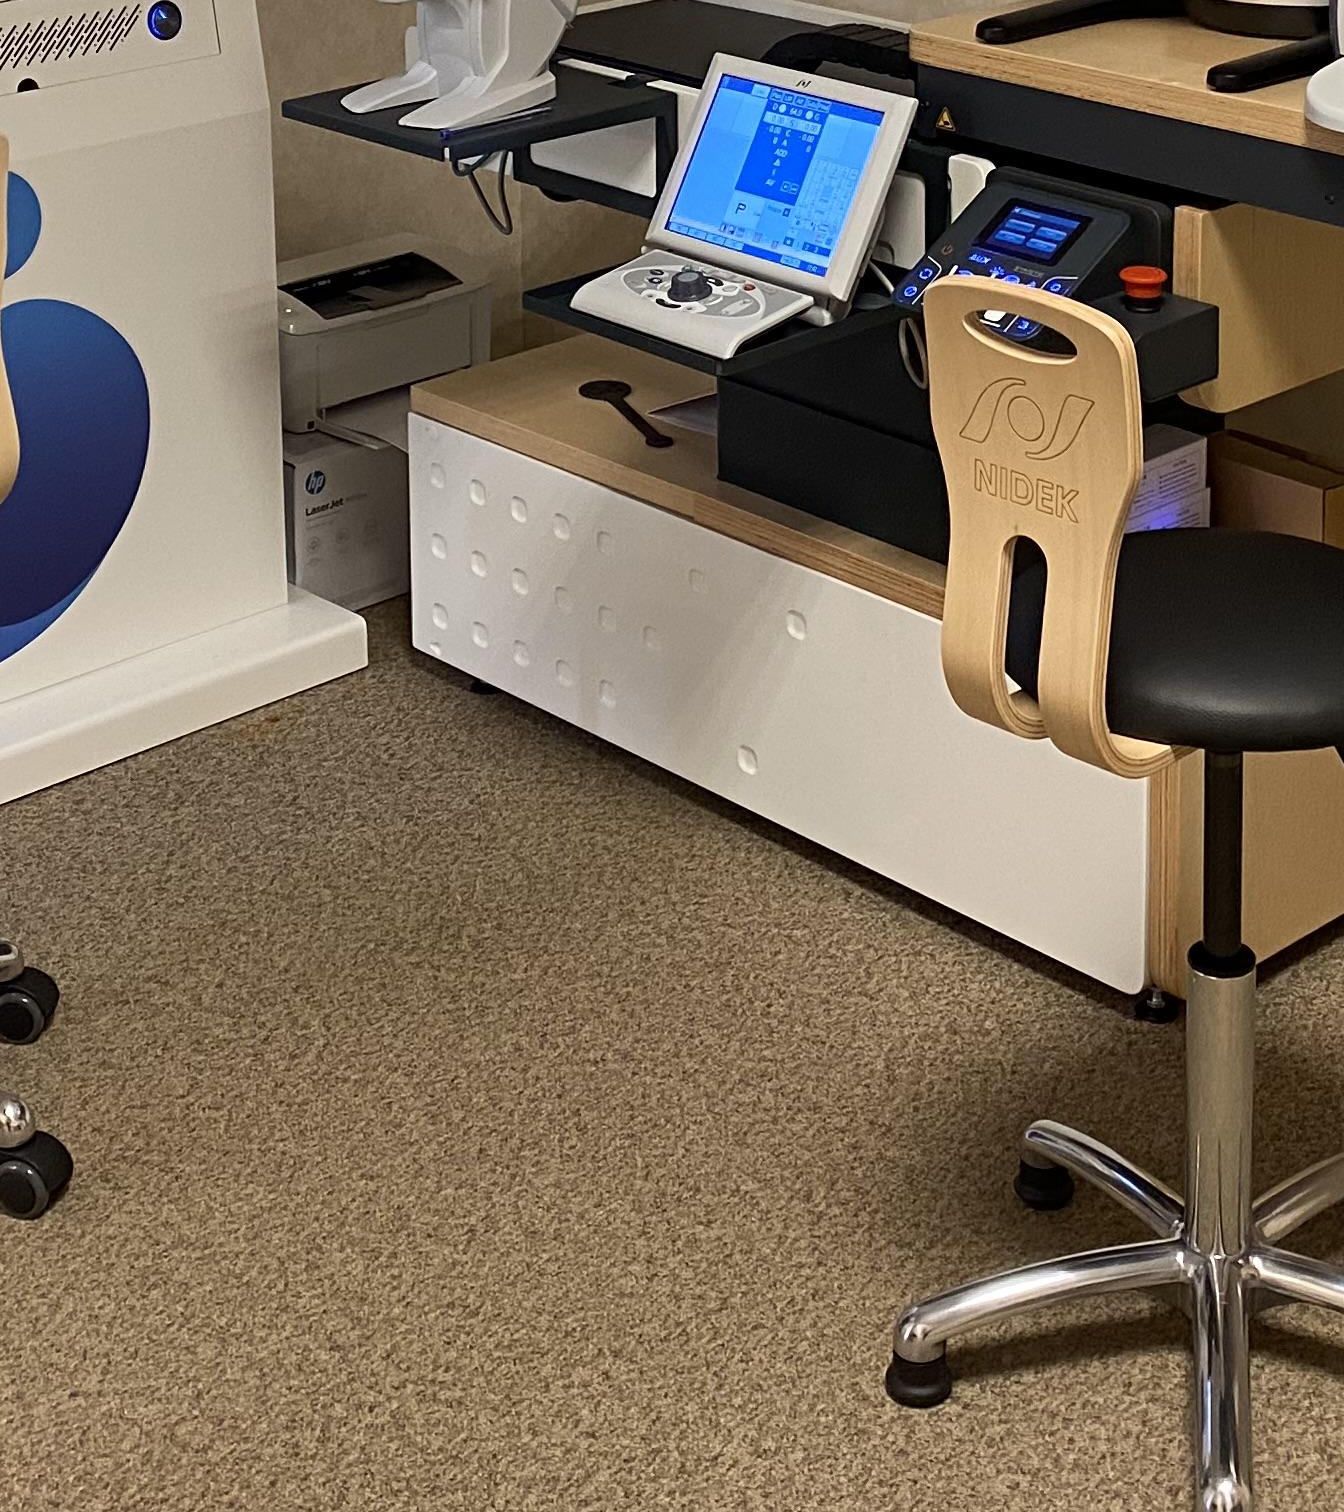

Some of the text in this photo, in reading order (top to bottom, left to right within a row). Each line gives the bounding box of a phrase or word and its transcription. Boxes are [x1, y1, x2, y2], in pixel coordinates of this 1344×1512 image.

[735, 202, 747, 215] P
[307, 470, 325, 495] hp
[973, 458, 1080, 524] NIDEK
[305, 498, 344, 517] LaserJet
